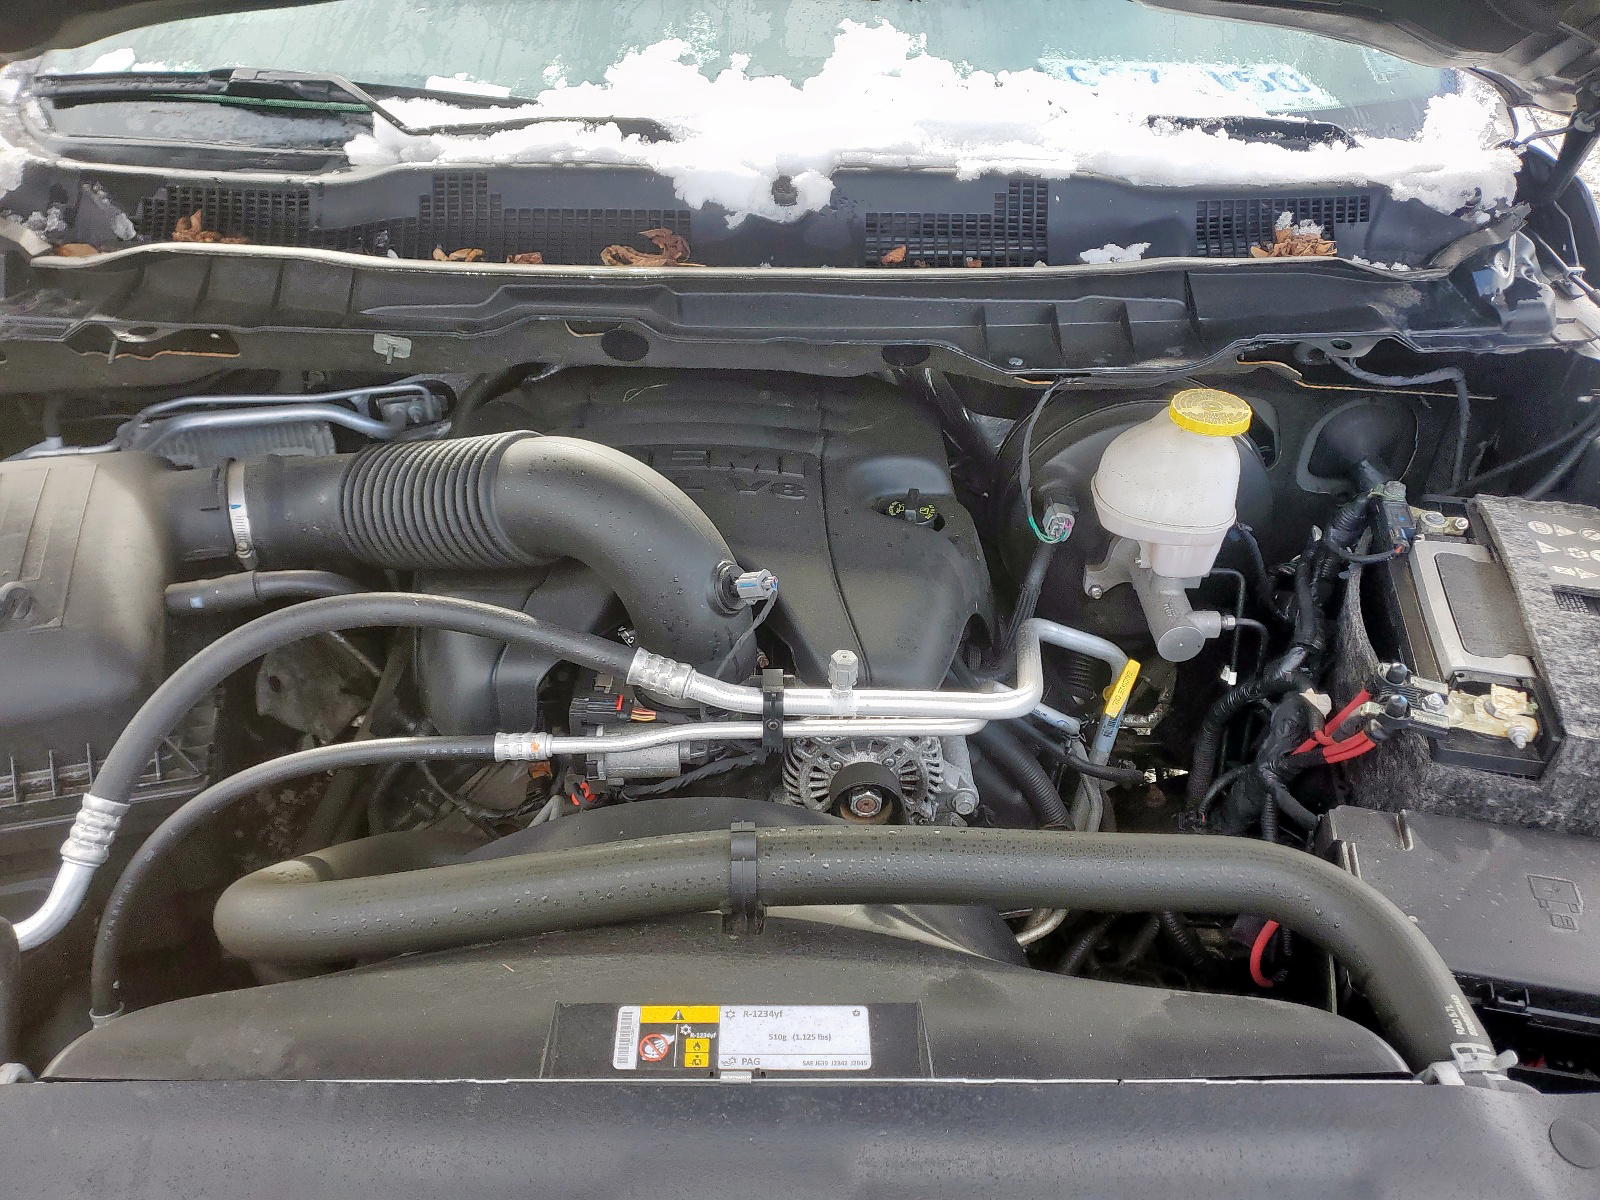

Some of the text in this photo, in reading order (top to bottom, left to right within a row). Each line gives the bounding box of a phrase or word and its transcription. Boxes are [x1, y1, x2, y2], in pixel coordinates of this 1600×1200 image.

[743, 1010, 784, 1018] R-1234yf
[768, 1033, 832, 1042] 510g (1.125 lbs)
[741, 1058, 761, 1066] PAG
